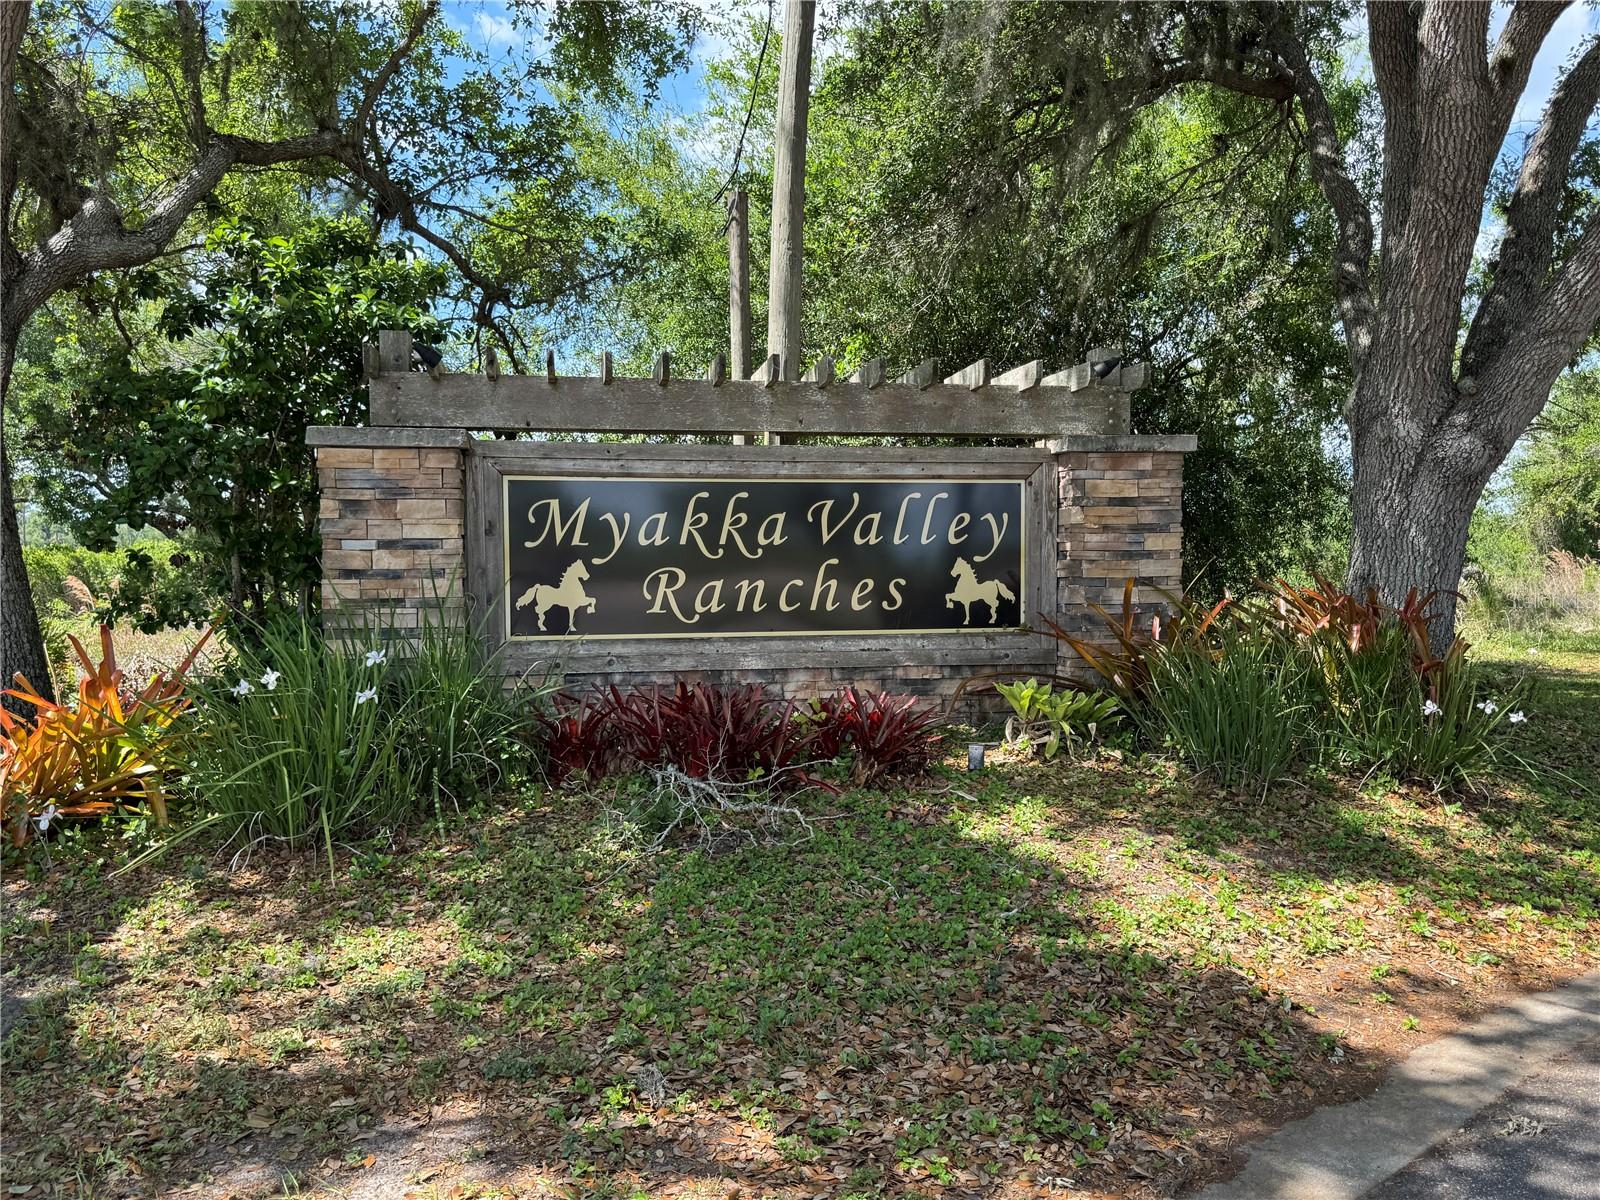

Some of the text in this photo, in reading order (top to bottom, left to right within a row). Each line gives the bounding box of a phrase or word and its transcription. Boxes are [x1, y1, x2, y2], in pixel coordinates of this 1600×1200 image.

[524, 491, 1009, 565] Myakka Valley
[642, 557, 907, 624] Ranches
